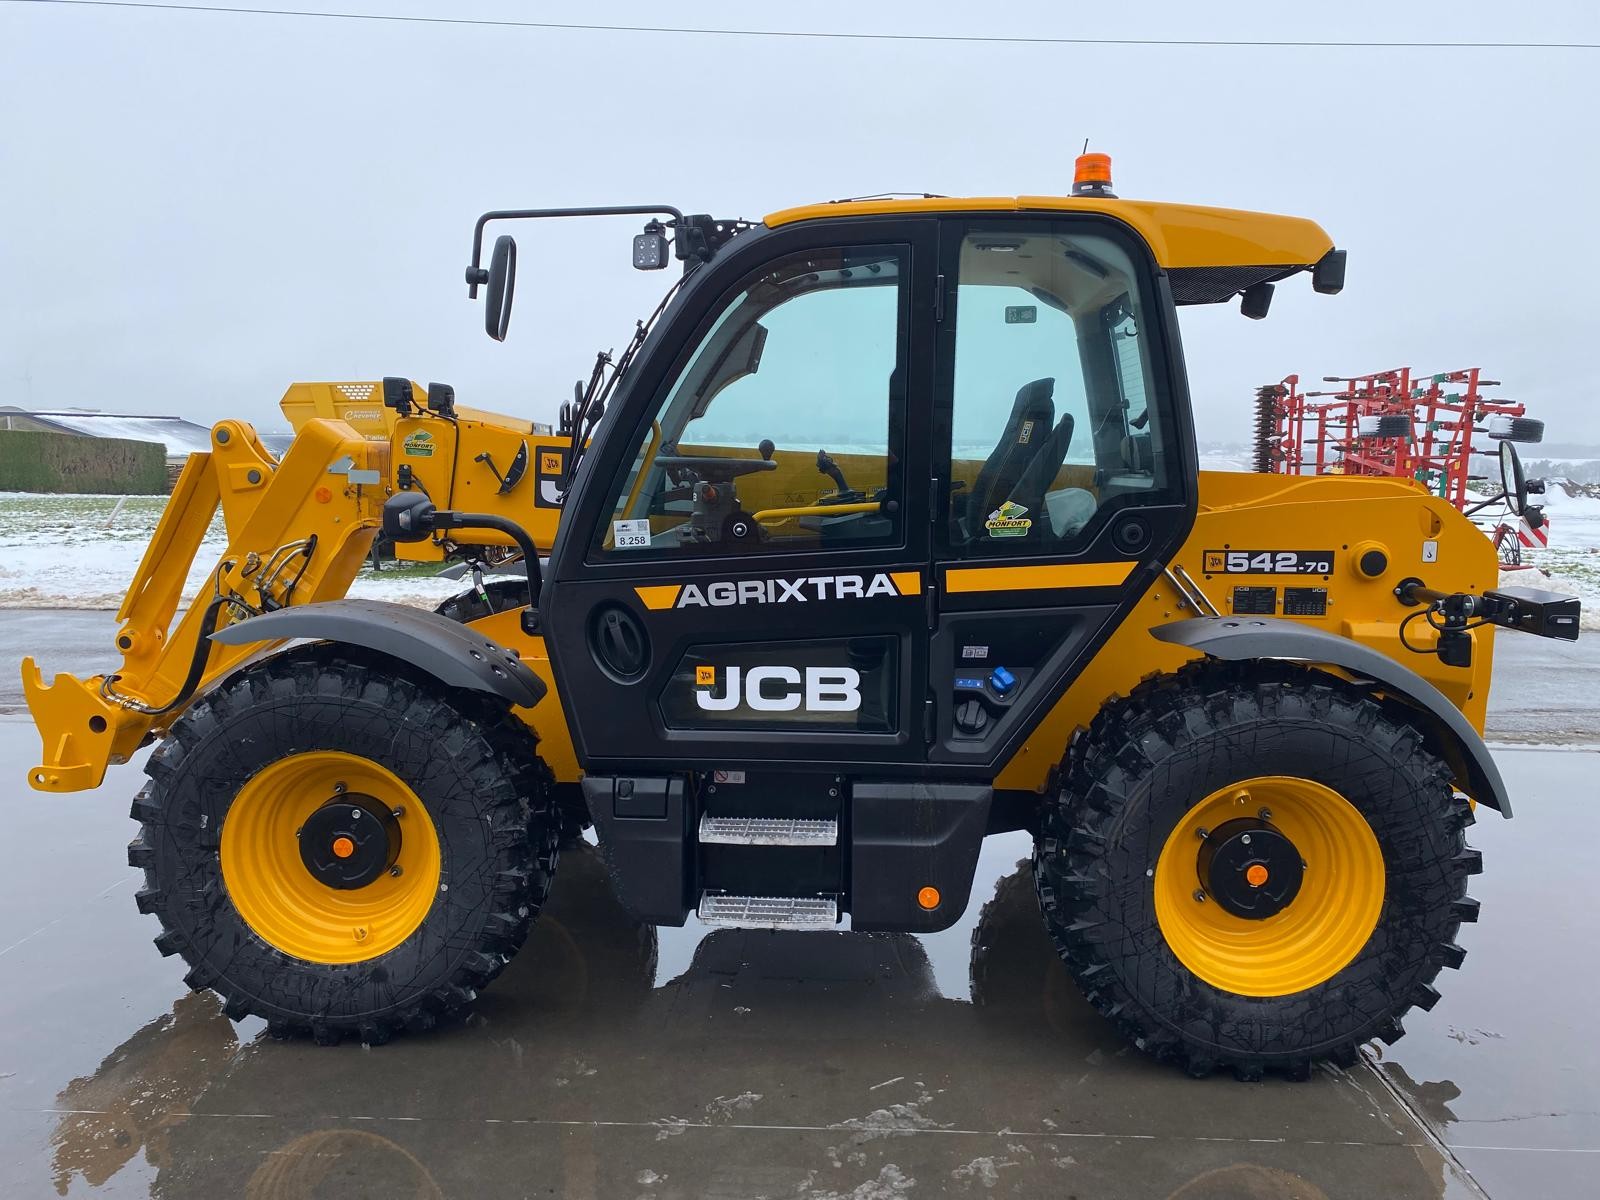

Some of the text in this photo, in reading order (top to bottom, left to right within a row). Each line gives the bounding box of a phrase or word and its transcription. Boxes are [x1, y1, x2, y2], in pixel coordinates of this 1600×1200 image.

[619, 536, 646, 545] 8.258
[676, 573, 898, 609] AGRIXTRA
[696, 666, 862, 711] JCB
